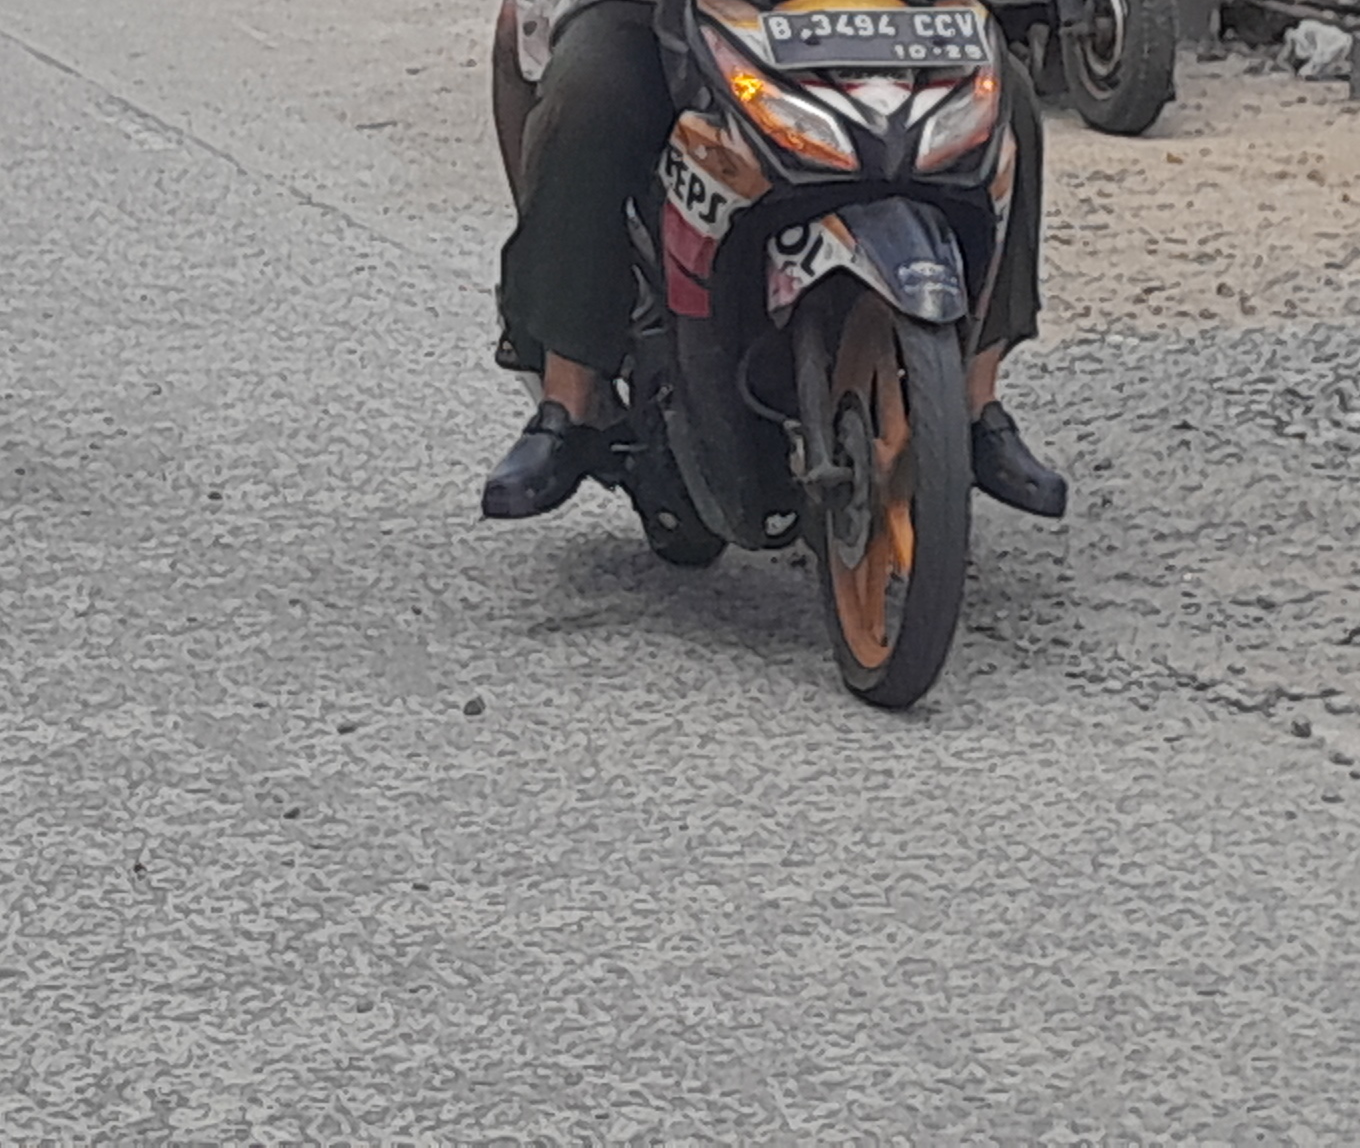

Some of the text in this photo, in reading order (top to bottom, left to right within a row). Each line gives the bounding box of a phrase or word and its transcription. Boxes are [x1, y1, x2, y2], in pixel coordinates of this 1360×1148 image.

[767, 8, 975, 40] B 3494 CCV
